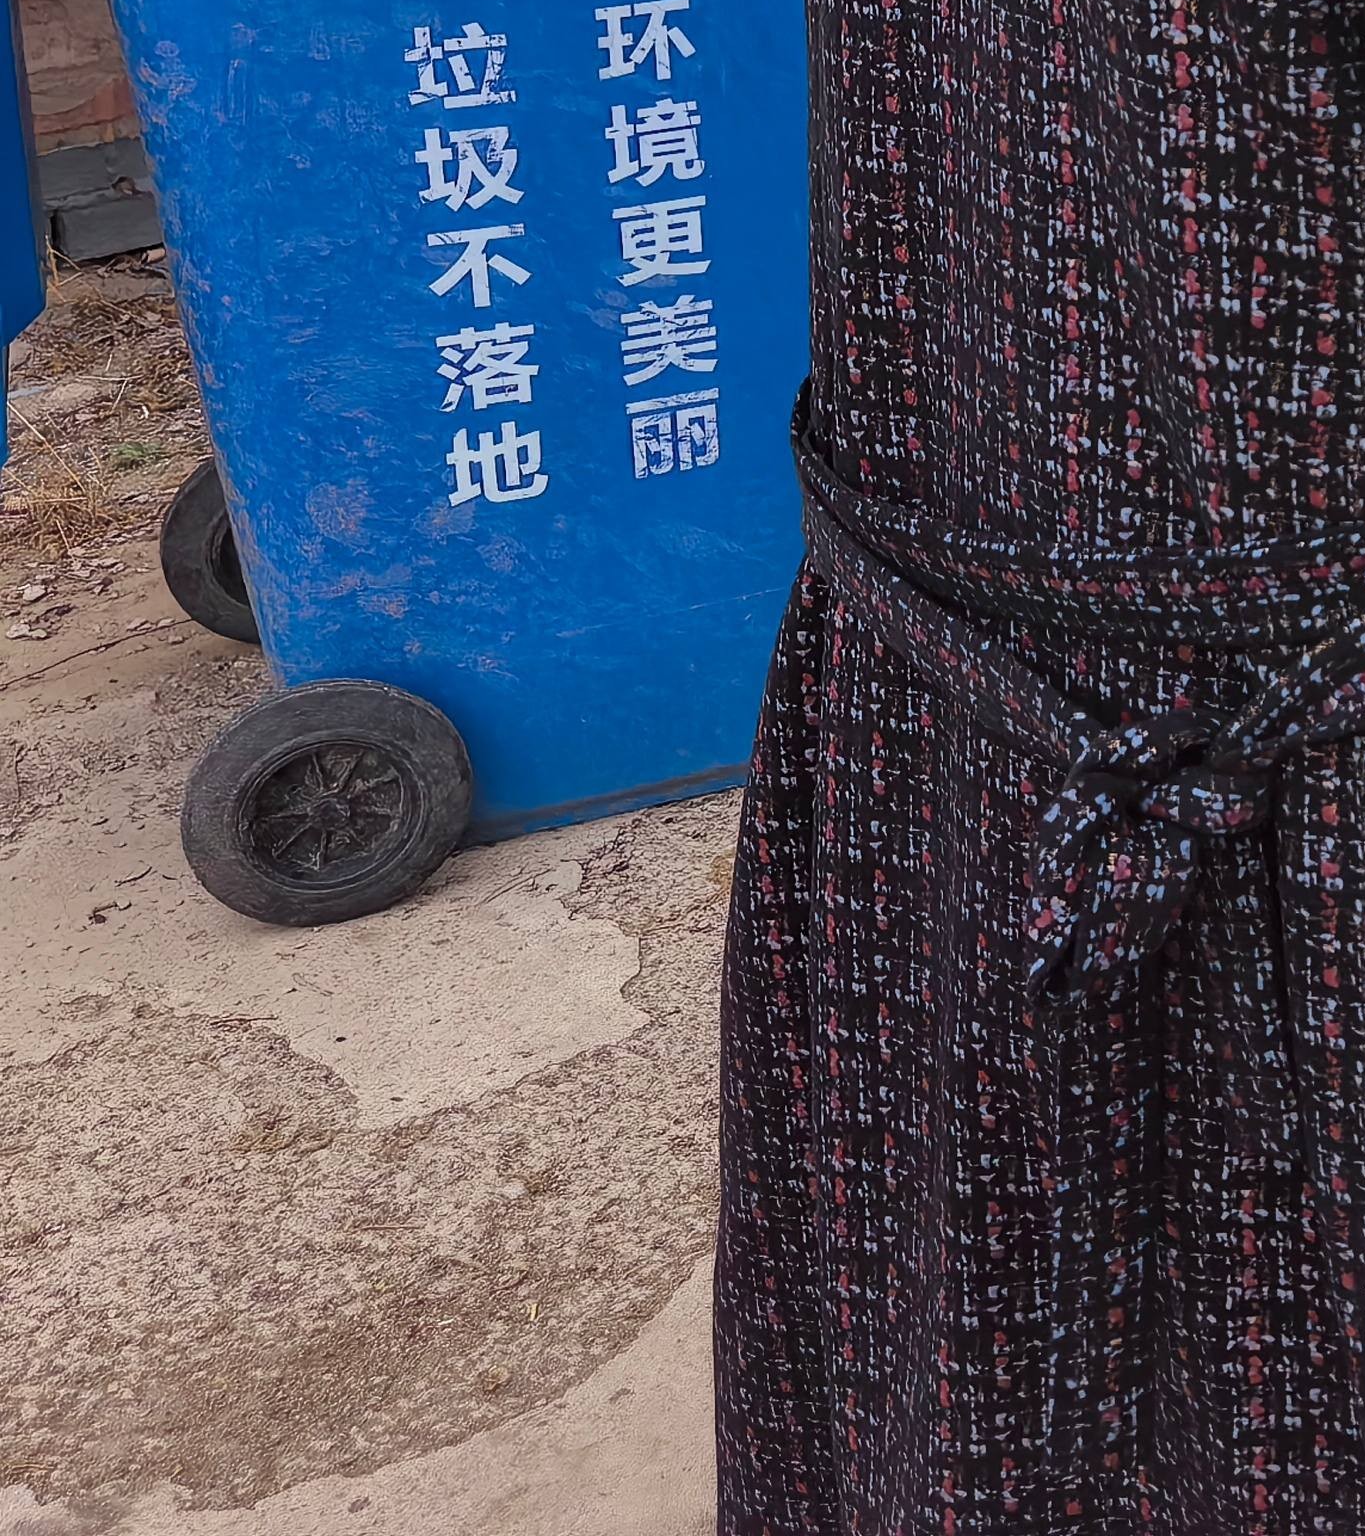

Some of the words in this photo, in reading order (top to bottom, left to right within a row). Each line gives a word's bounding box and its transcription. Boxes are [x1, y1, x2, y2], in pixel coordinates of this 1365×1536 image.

[404, 22, 549, 507] 垃圾不落地
